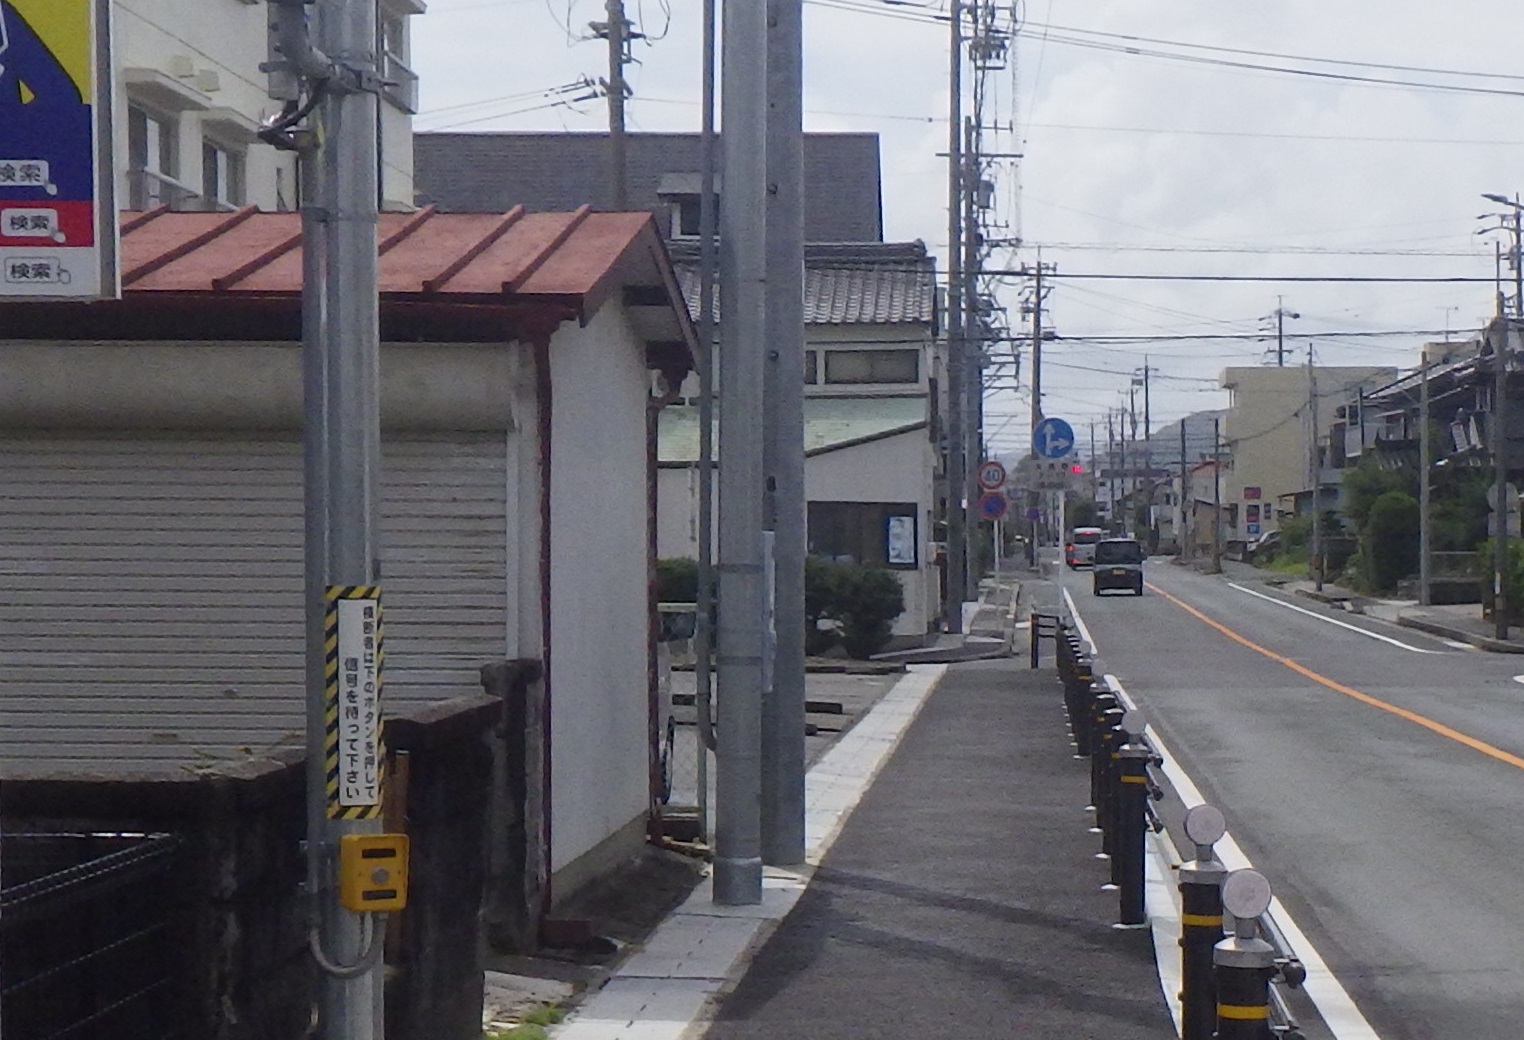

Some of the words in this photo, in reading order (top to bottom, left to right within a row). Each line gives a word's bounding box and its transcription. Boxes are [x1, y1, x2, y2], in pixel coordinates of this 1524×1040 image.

[10, 215, 49, 230] 検索
[11, 262, 51, 279] 検索
[985, 469, 1000, 482] 40
